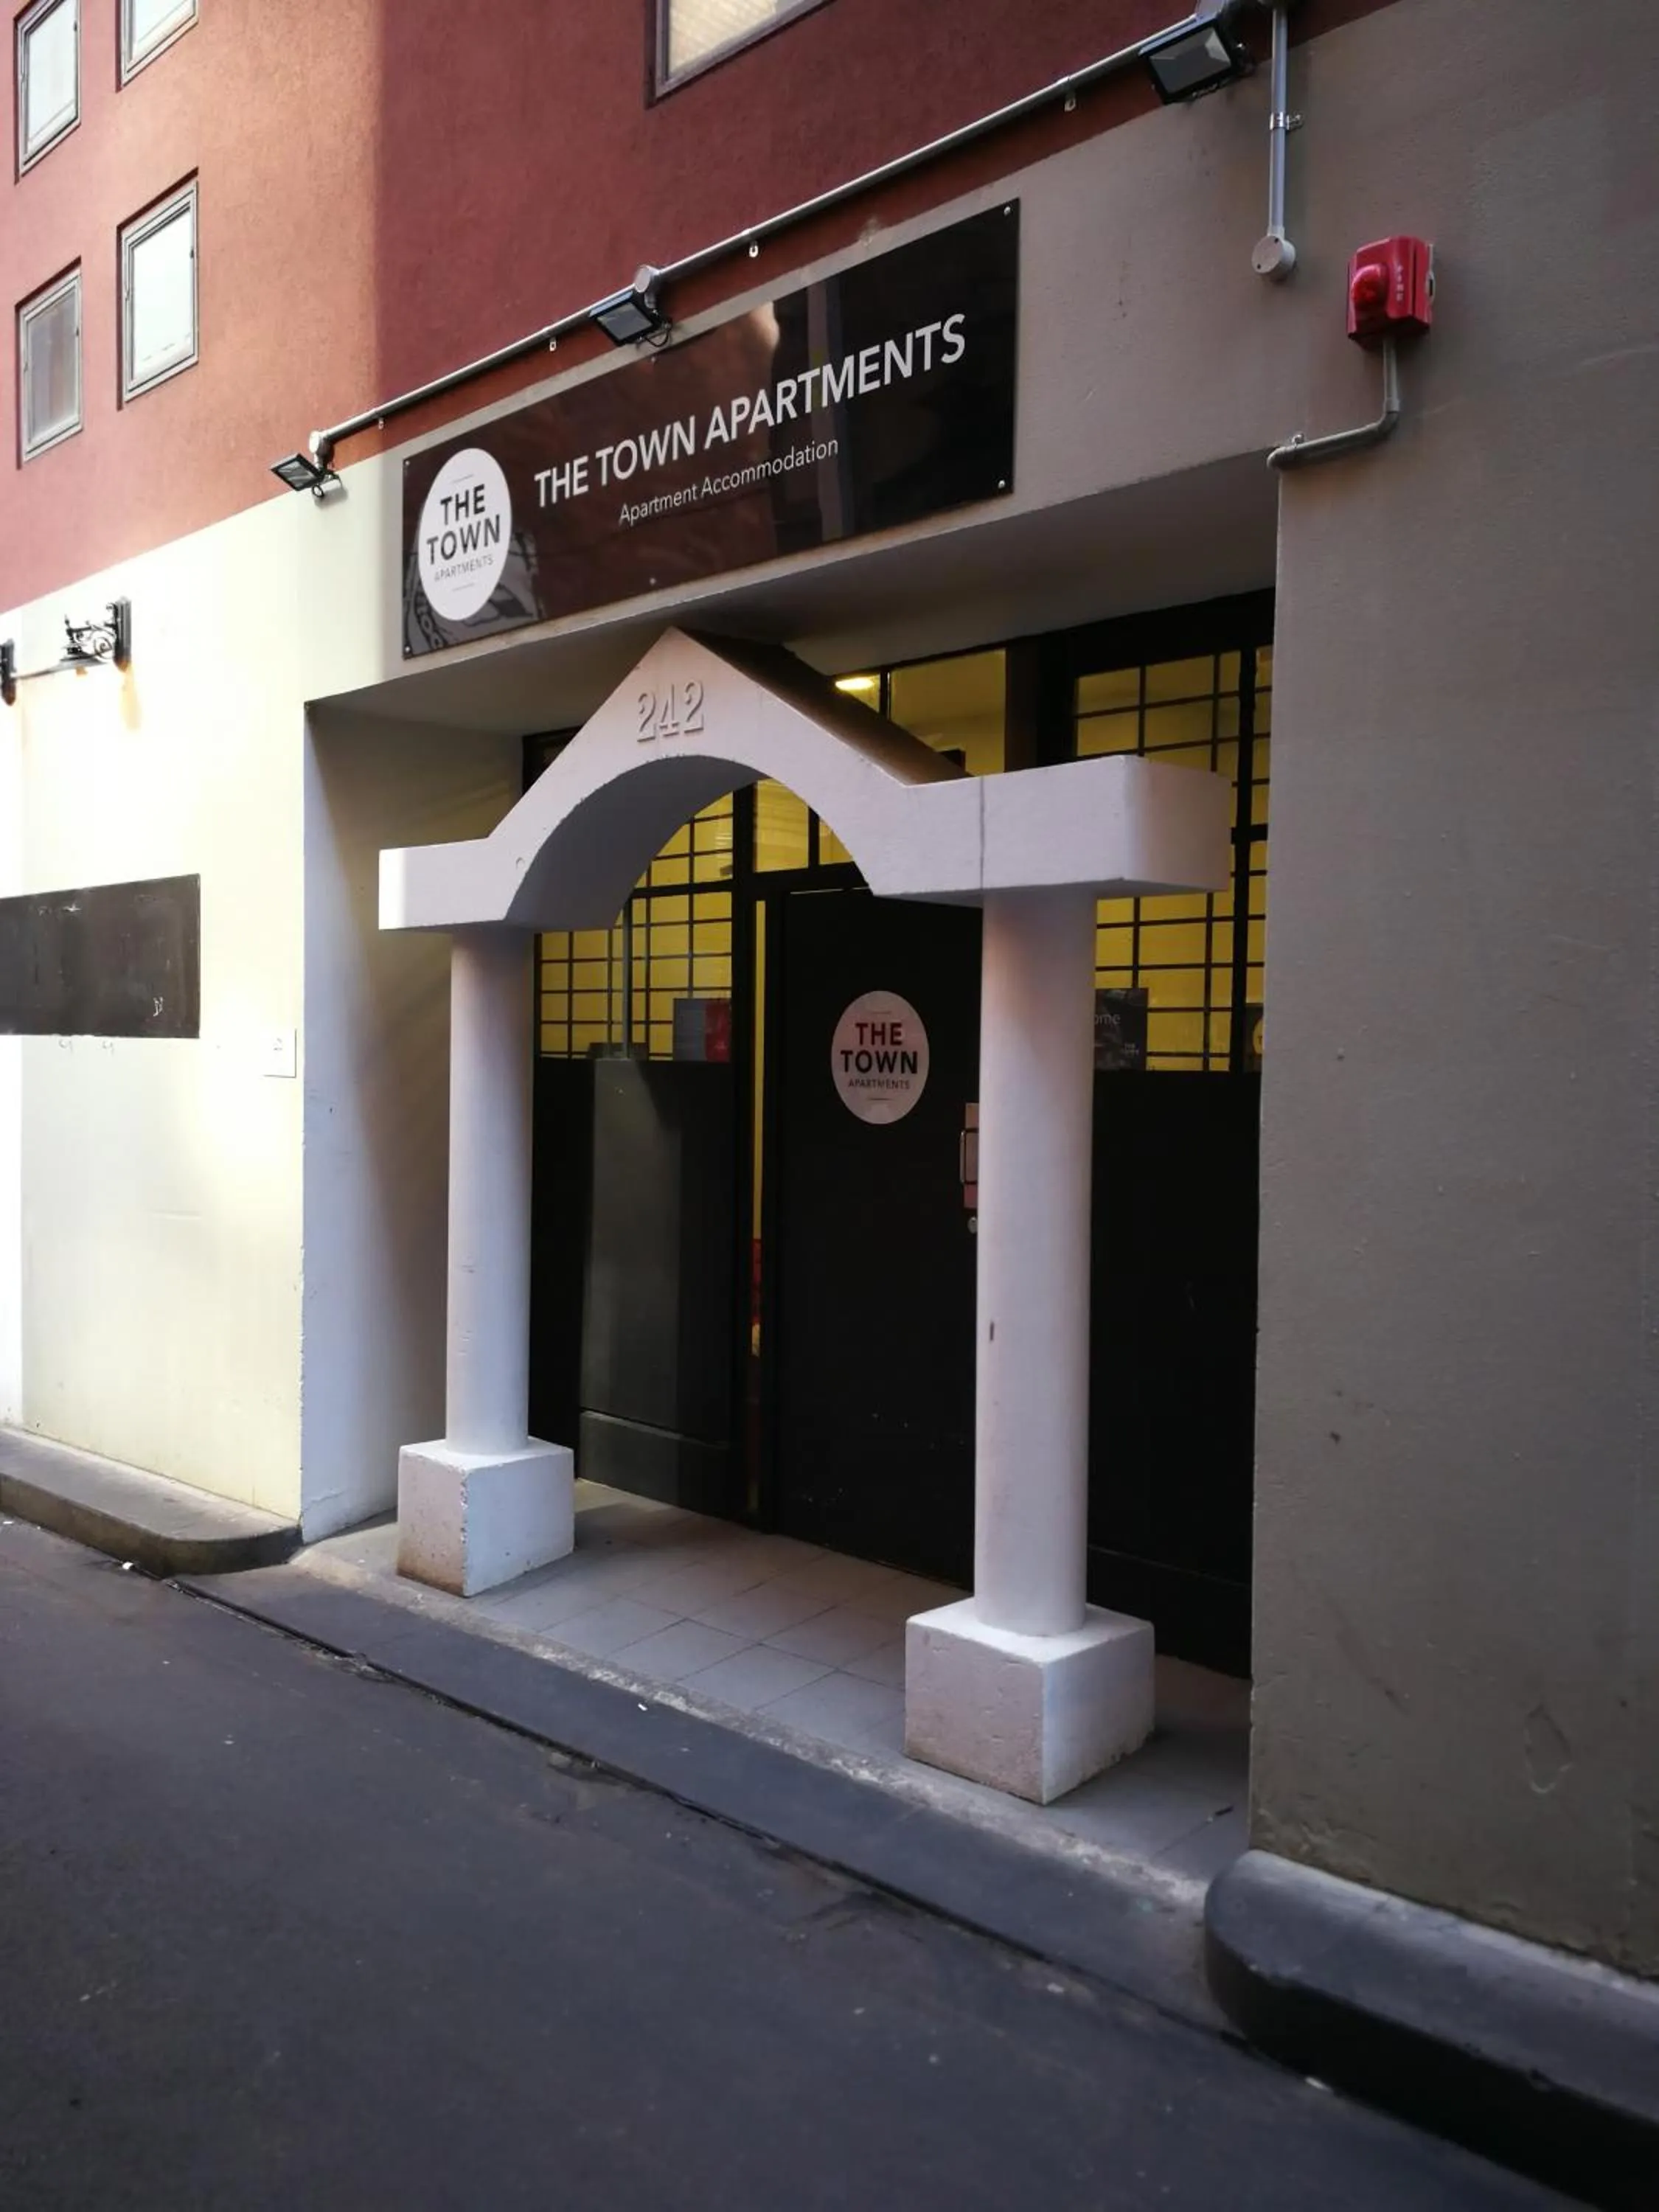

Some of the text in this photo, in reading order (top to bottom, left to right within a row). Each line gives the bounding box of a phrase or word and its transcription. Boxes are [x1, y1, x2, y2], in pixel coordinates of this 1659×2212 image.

[534, 313, 966, 508] THE TOWN APARTMENTS
[618, 437, 839, 527] Apartment Accommodation
[440, 484, 485, 525] THE
[426, 514, 500, 565] TOWN
[434, 554, 494, 582] APARTMENTS
[636, 681, 705, 742] 242
[855, 1022, 903, 1046] THE
[840, 1049, 919, 1074] TOWN
[849, 1078, 911, 1090] APARTMENTS
